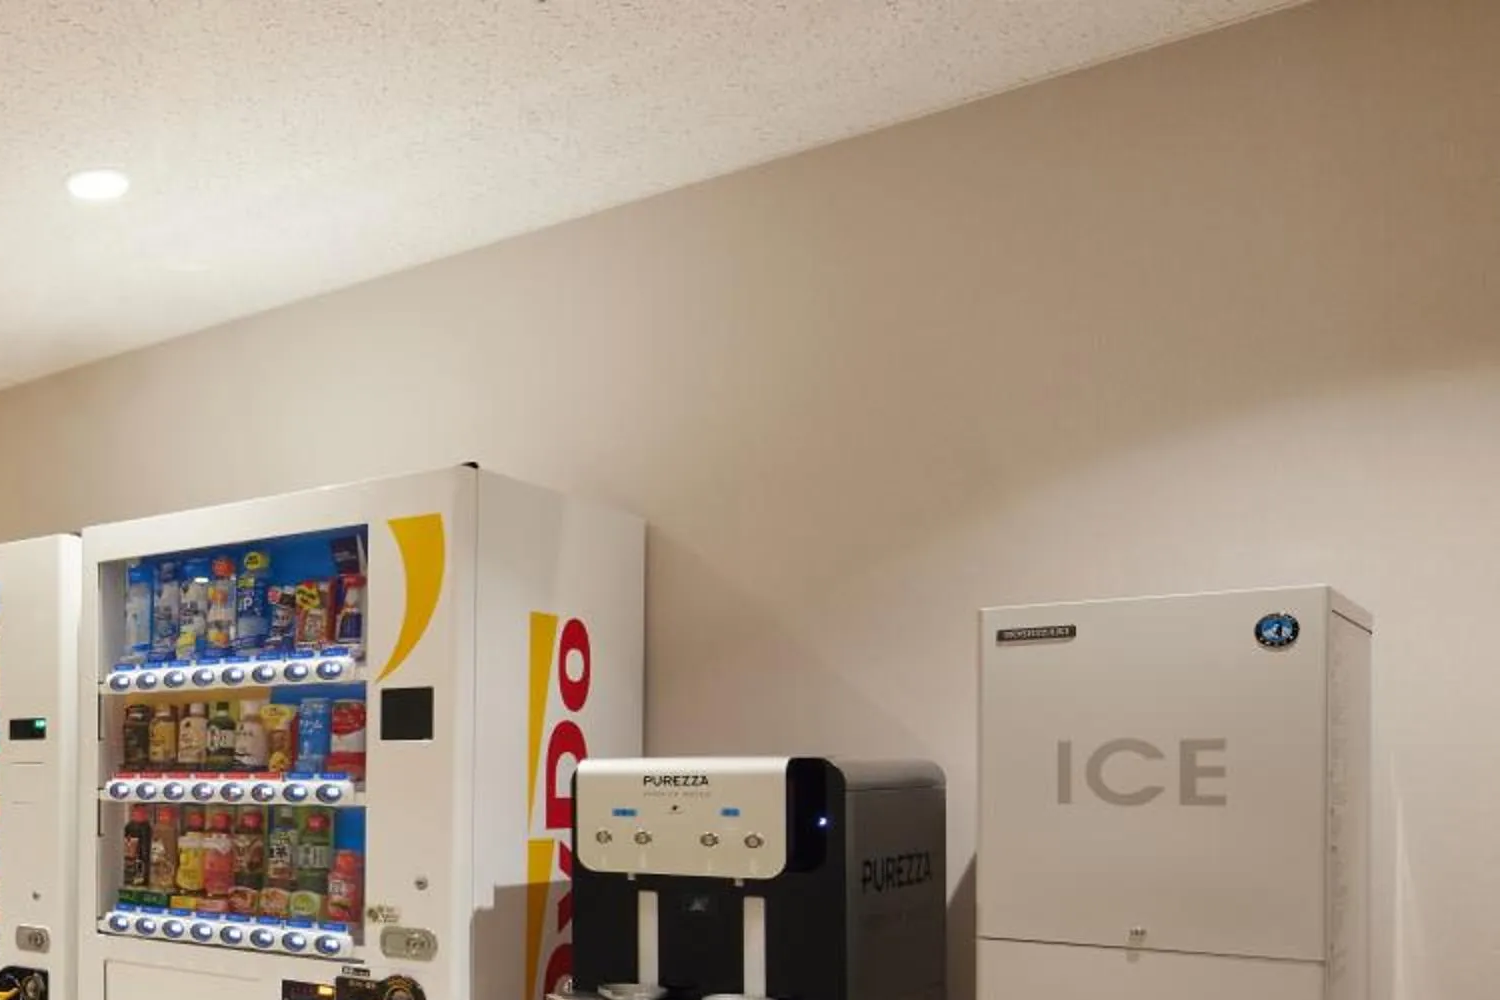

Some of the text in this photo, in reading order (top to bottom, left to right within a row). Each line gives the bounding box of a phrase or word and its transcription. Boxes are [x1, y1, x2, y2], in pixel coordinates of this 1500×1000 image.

[643, 775, 709, 787] PUREZZA
[1057, 737, 1228, 806] ICE
[861, 850, 933, 894] PUREZZA
